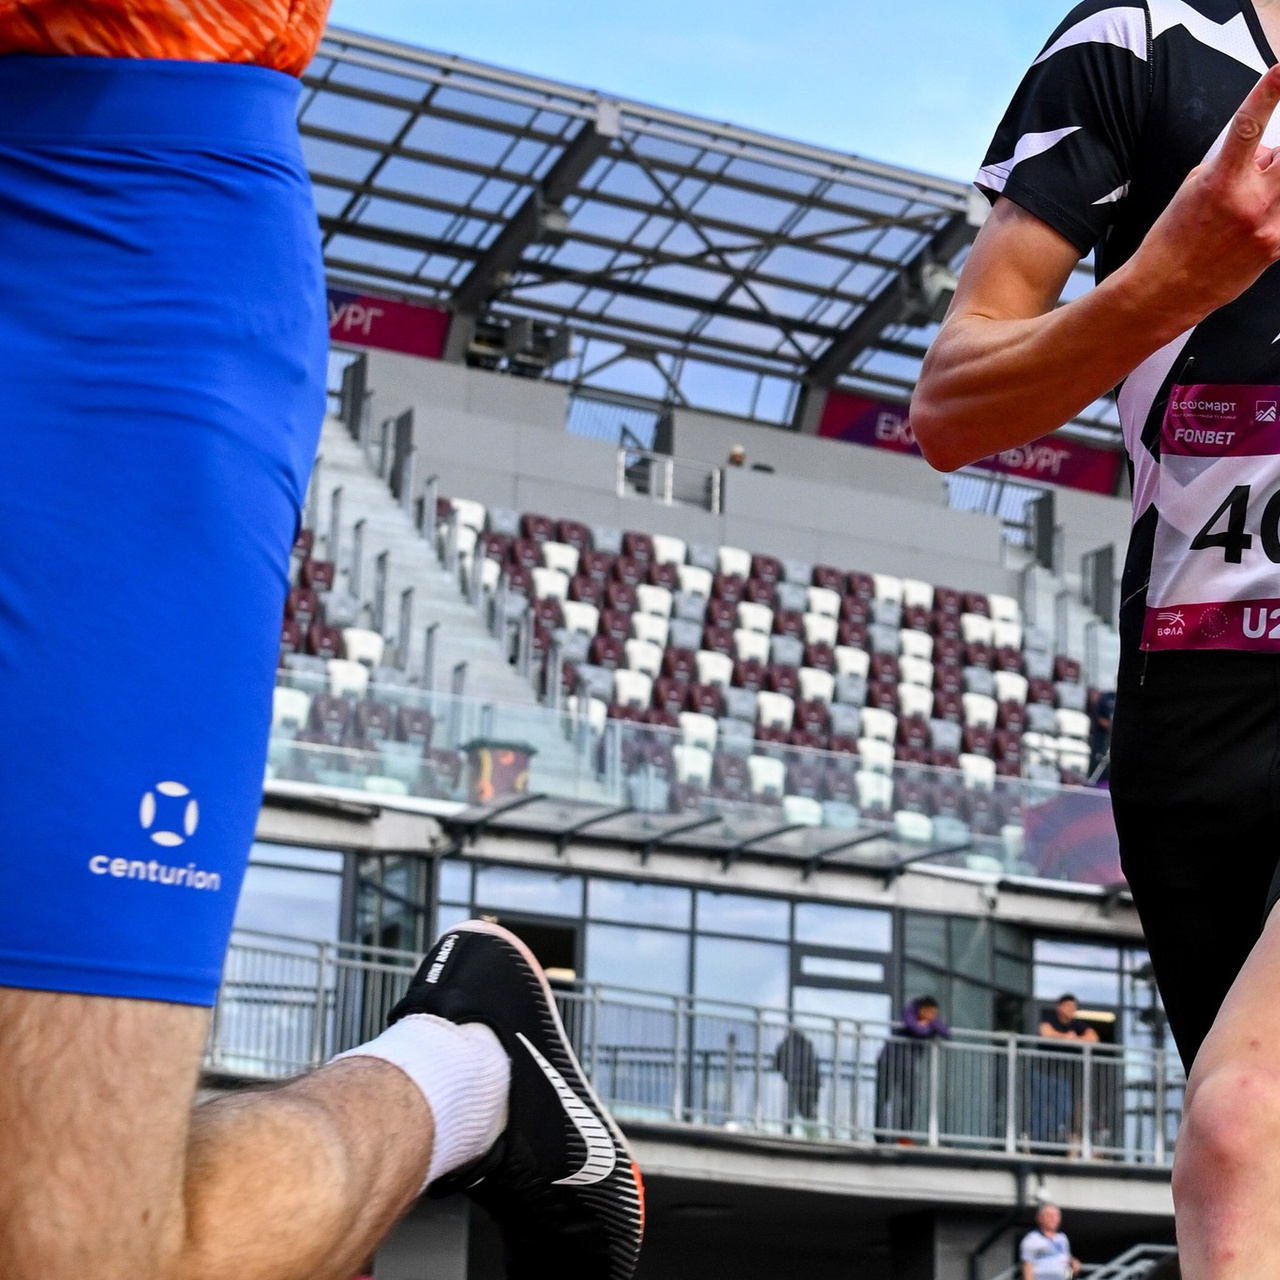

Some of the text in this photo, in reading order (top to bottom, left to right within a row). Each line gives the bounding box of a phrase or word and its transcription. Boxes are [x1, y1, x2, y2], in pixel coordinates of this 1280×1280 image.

[1174, 428, 1236, 445] FONBET
[1157, 626, 1184, 637] ВФЛА
[89, 854, 221, 891] centurion
